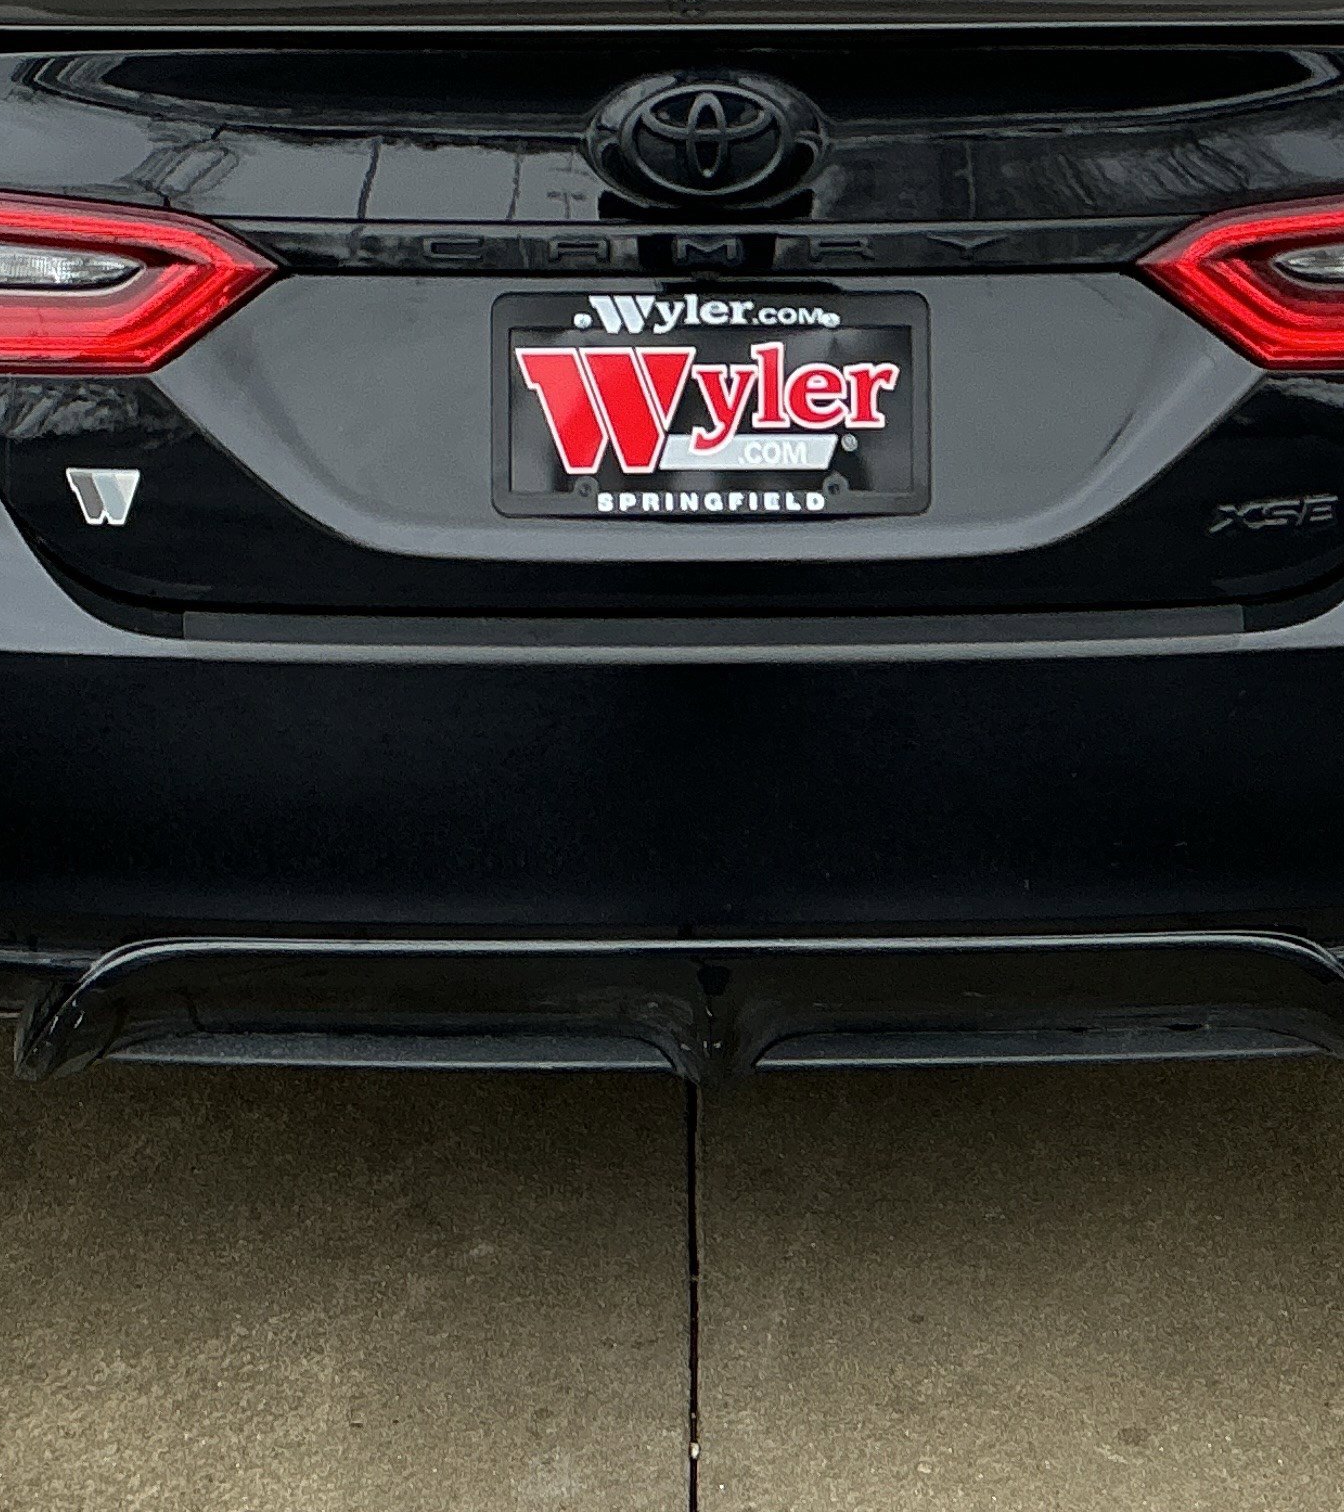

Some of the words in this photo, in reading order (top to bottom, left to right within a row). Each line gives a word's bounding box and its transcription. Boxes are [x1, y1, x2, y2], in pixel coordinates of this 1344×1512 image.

[422, 233, 1007, 262] CAMRY
[515, 342, 900, 475] Wyler
[597, 492, 827, 512] SPRINGFIELD
[1209, 494, 1339, 534] XSE
